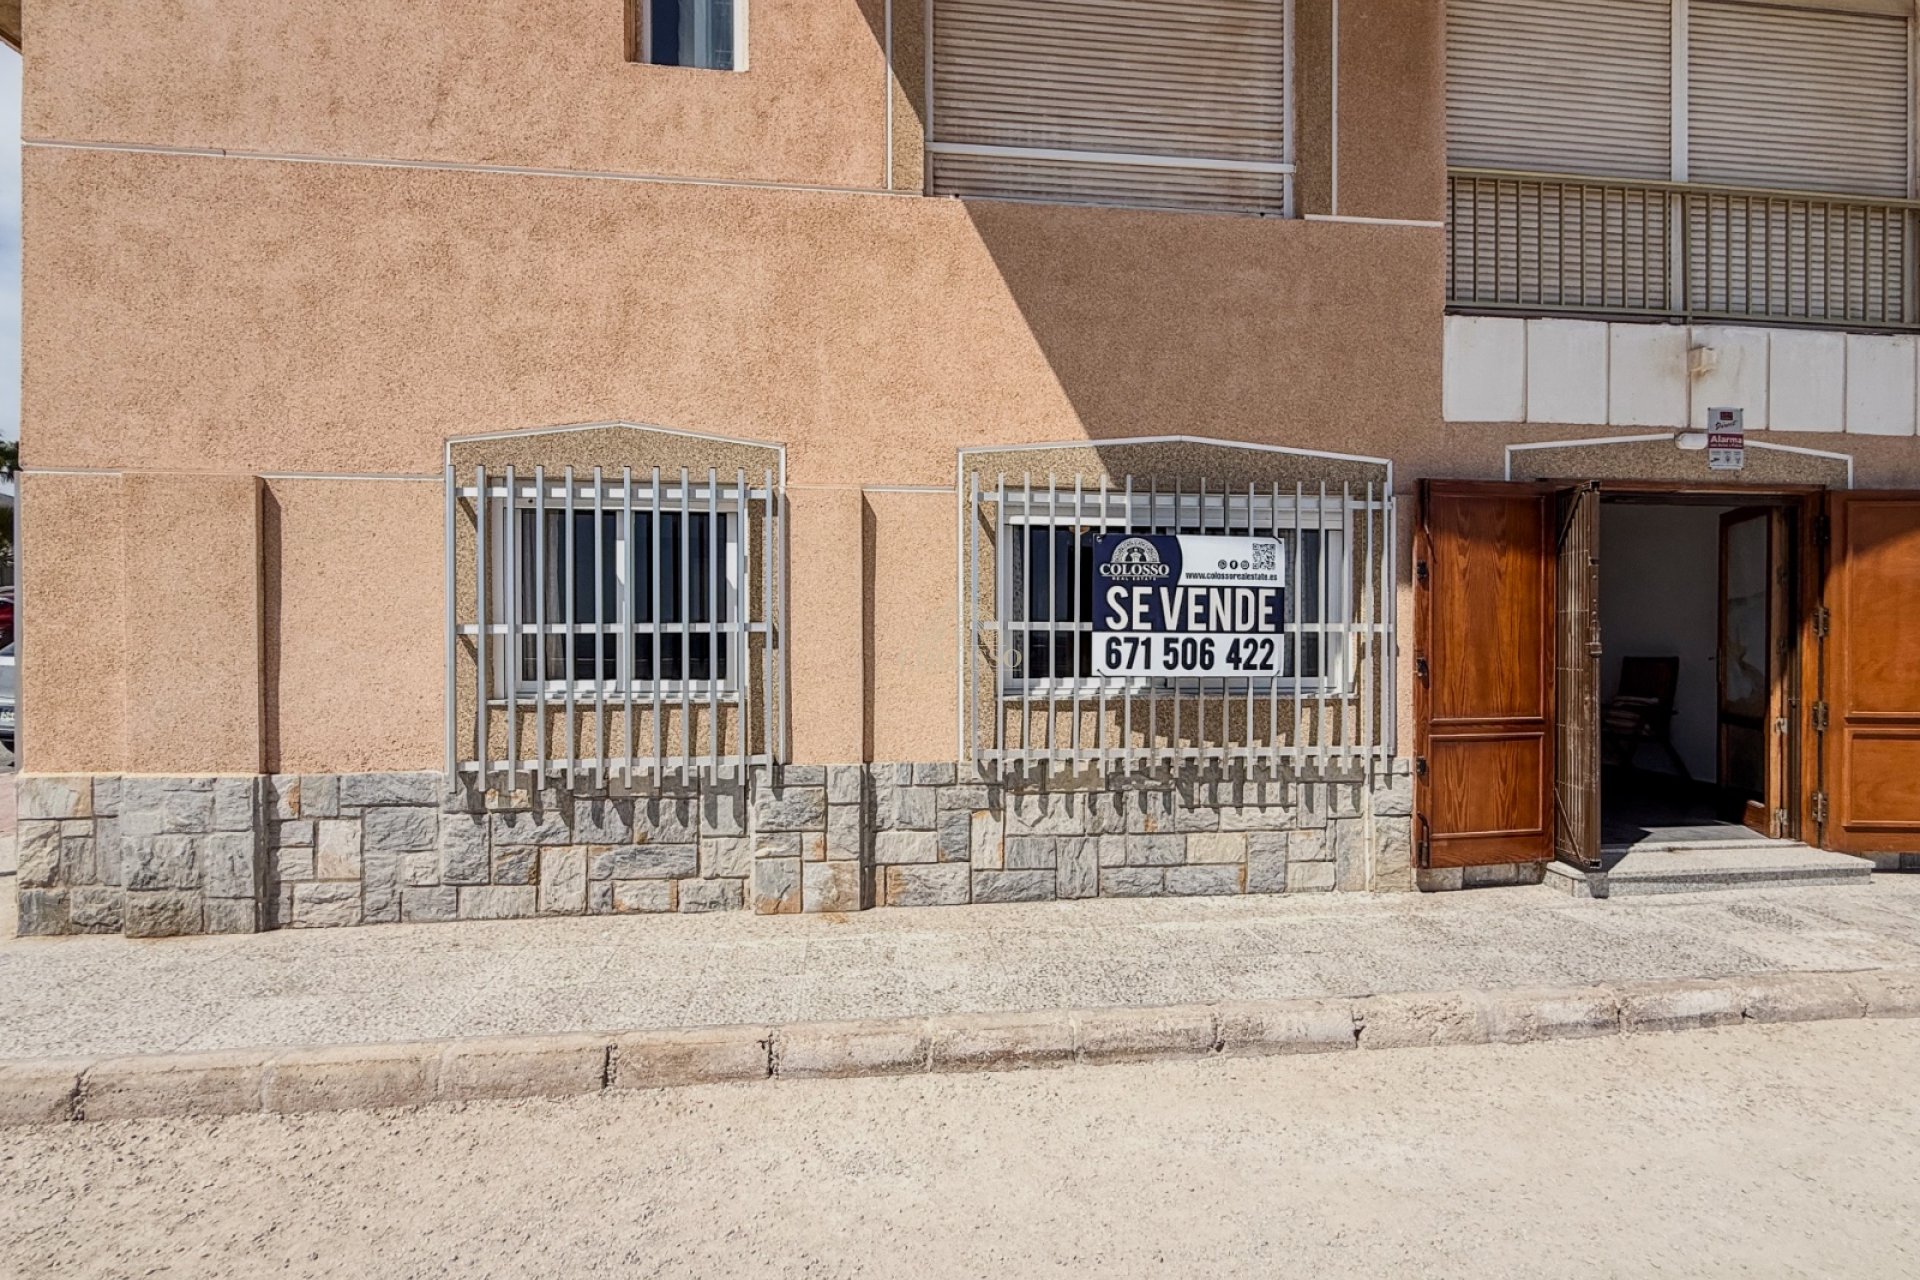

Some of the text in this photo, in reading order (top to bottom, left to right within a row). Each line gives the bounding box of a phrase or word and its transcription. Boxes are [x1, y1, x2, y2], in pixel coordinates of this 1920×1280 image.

[1710, 435, 1742, 443] Alarma
[1099, 563, 1170, 576] COLOSSO
[1185, 572, 1278, 581] www.colossorealestate.es
[1105, 585, 1277, 632] SE VENDE
[1105, 636, 1275, 671] 671 506 422
